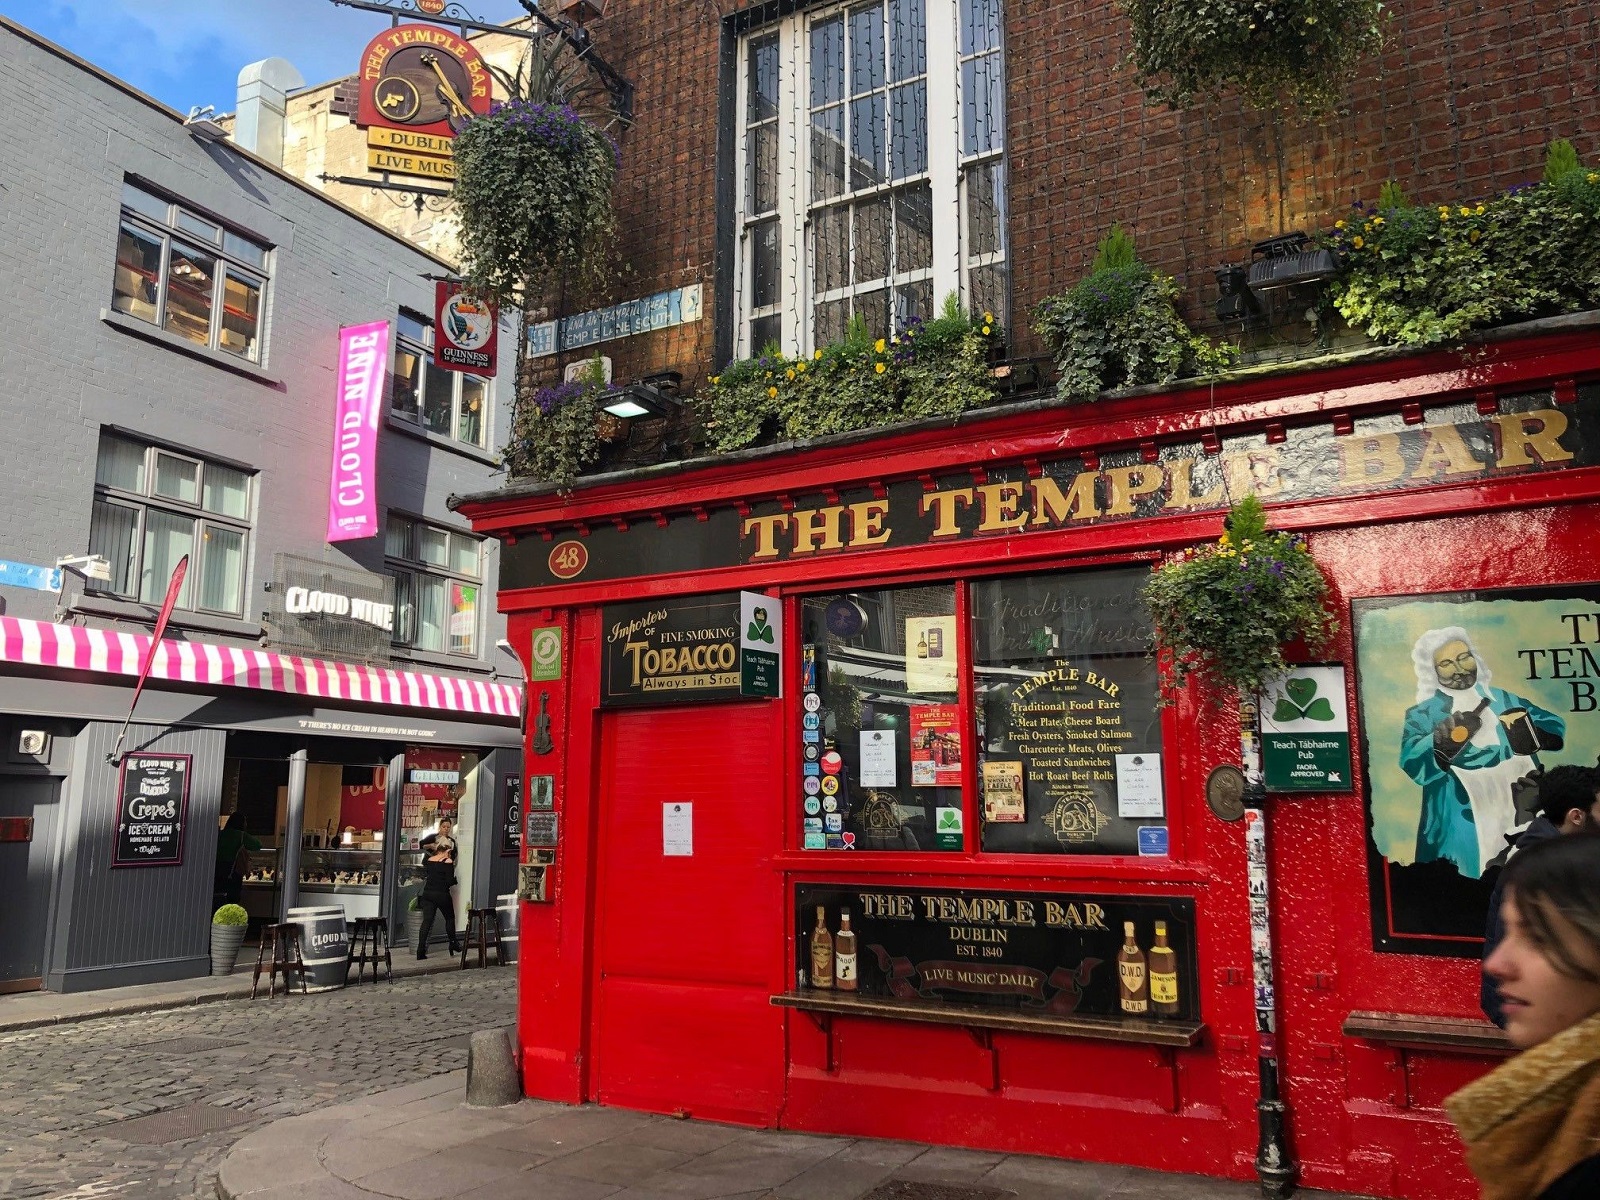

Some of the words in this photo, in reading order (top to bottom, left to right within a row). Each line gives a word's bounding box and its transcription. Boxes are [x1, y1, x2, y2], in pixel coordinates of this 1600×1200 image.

[421, 0, 441, 9] 1840
[365, 44, 389, 80] THE
[387, 30, 468, 58] TEMPLE
[465, 58, 487, 97] BAR
[391, 132, 453, 151] DUBLIN
[376, 154, 413, 169] LIVE
[418, 158, 457, 174] MUS
[635, 311, 672, 331] SOUTH
[443, 347, 489, 362] GUINNESS
[345, 330, 380, 402] NINE
[338, 410, 366, 507] CLOUD
[743, 500, 891, 559] THE
[922, 448, 1284, 541] TEMPLE
[1335, 408, 1576, 492] BAR
[556, 547, 580, 569] 48
[286, 586, 350, 616] CLOUD
[350, 598, 394, 631] NINE
[607, 607, 669, 643] Importers
[644, 627, 656, 637] OF
[660, 631, 684, 644] FINE
[686, 627, 736, 641] SMOKING
[623, 640, 738, 688] TOBACCO
[756, 665, 765, 673] Pub
[1054, 659, 1070, 667] The
[644, 678, 687, 690] Always
[693, 676, 705, 687] in
[709, 673, 738, 685] Stoc
[1011, 667, 1080, 700] TEMPLE
[1084, 670, 1120, 698] BAR
[1011, 701, 1066, 713] Traditional
[1069, 700, 1094, 710] Food
[1097, 699, 1121, 710] Fare
[942, 712, 956, 720] BAR
[1018, 716, 1038, 727] Meat
[1040, 717, 1063, 727] Plate,
[1064, 716, 1093, 726] Cheese
[1095, 715, 1121, 725] Board
[341, 723, 351, 731] ICE
[351, 724, 370, 733] CREAM
[377, 726, 398, 735] HEAVEN
[1008, 731, 1030, 741] Fresh
[1031, 730, 1064, 743] Oysters,
[1065, 729, 1098, 740] Smoked
[1100, 730, 1133, 740] Salmon
[1018, 743, 1066, 754] Charcuterie
[1067, 743, 1095, 754] Meats,
[1096, 742, 1123, 752] Olives
[1272, 740, 1297, 749] Teach
[1298, 740, 1340, 750] Tábhairne
[1030, 756, 1061, 767] Toasted
[1063, 756, 1112, 767] Sandwiches
[1298, 751, 1315, 760] Pub
[139, 760, 159, 769] CLOUD
[160, 760, 175, 770] NINE
[415, 772, 455, 781] GELATO
[1029, 770, 1044, 780] Hot
[1046, 770, 1069, 781] Roast
[1071, 770, 1090, 780] Beef
[1092, 770, 1115, 780] Rolls
[128, 797, 176, 821] Crepes
[128, 825, 141, 836] ICE
[147, 824, 172, 835] CREAM
[859, 892, 916, 921] THE
[920, 895, 1037, 928] TEMPLE
[1043, 900, 1112, 932] BAR
[311, 933, 340, 947] CLOUD
[948, 926, 1008, 943] DUBLIN
[955, 944, 978, 957] EST.
[982, 946, 1004, 959] 1840
[923, 969, 954, 982] LIVE
[999, 973, 1038, 988] DAILY
[1121, 964, 1145, 978] D.W.D.
[1125, 1000, 1145, 1011] D.W.D.
